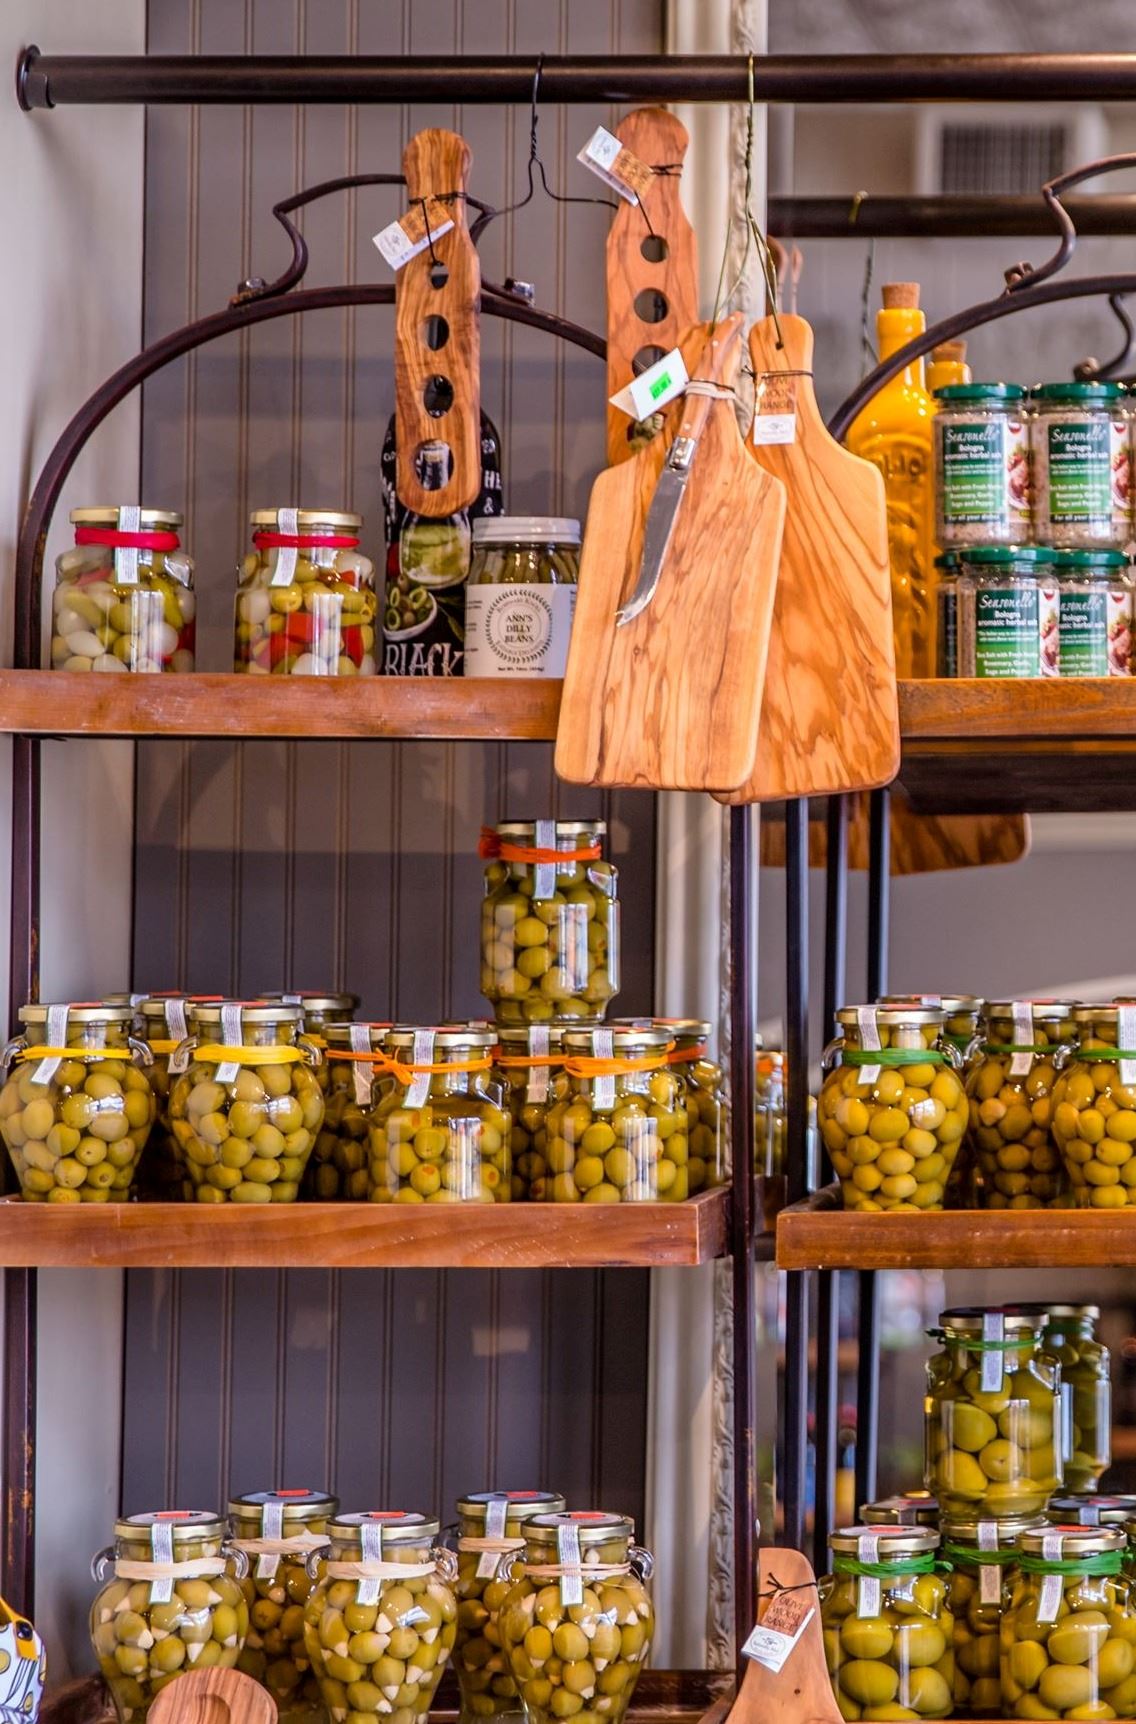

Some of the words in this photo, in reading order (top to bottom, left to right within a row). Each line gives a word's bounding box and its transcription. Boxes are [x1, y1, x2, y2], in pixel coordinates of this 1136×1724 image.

[959, 444, 985, 453] Bologna
[1065, 443, 1092, 453] Bologna
[506, 614, 533, 622] ANN'S
[994, 610, 1021, 619] Bologna
[1062, 614, 1088, 622] Bologna
[506, 625, 531, 633] DILLY
[504, 635, 534, 643] BEANS
